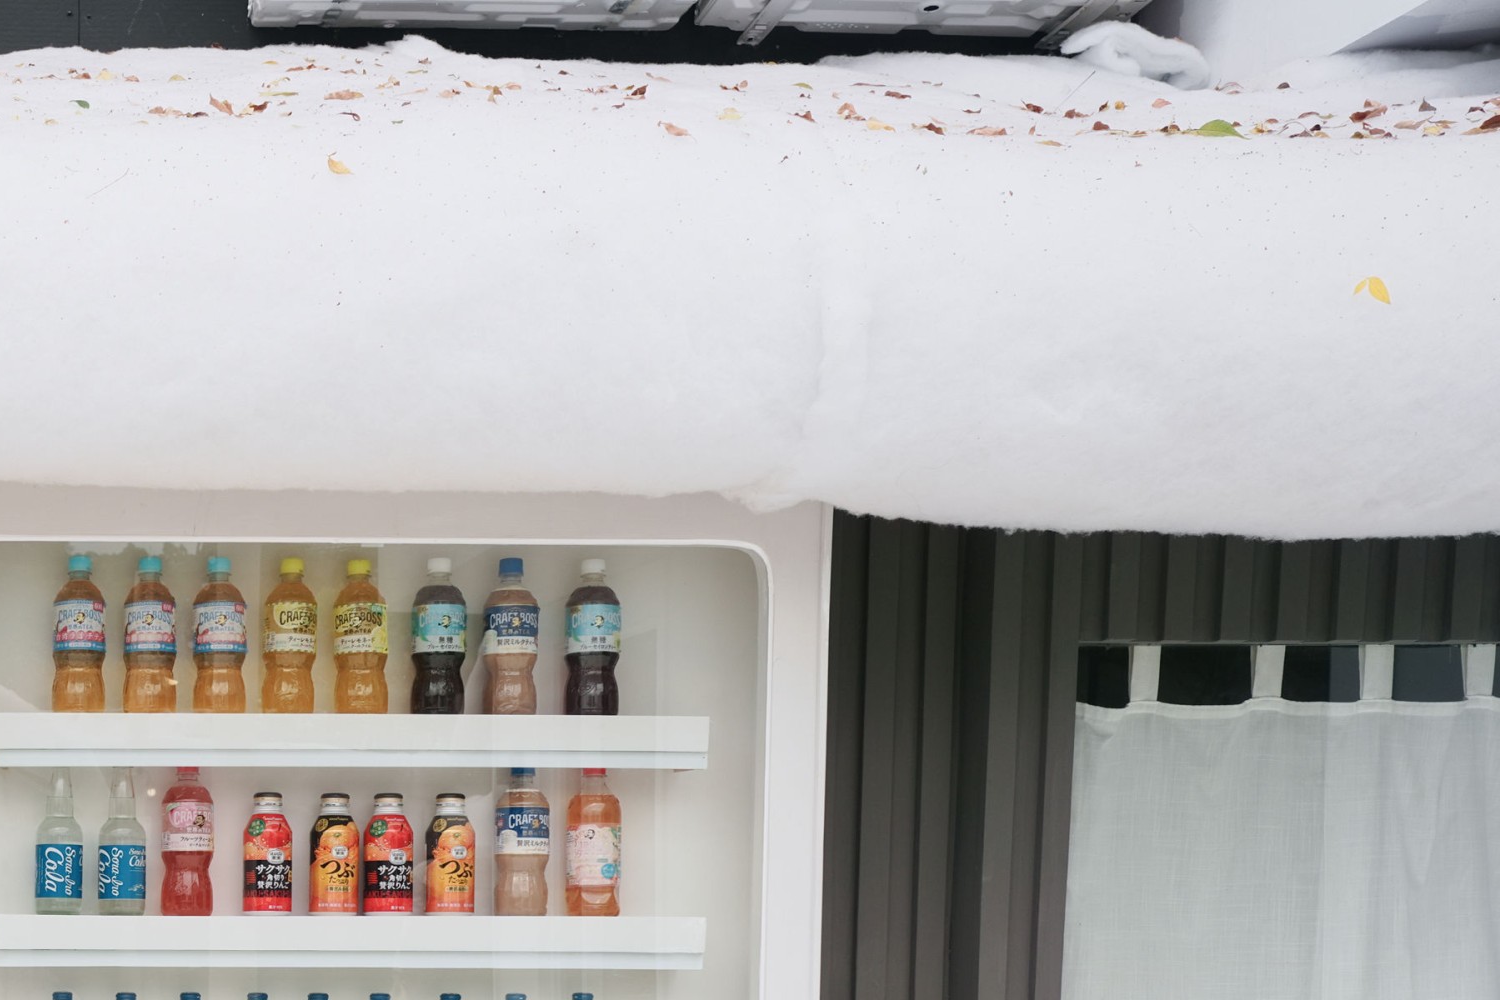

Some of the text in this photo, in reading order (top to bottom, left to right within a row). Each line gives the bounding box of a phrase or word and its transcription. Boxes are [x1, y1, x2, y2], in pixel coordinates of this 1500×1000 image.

[45, 846, 65, 892] Cola
[256, 864, 290, 875] サクサク
[320, 860, 356, 878] つぶ
[439, 860, 474, 878] つぶ
